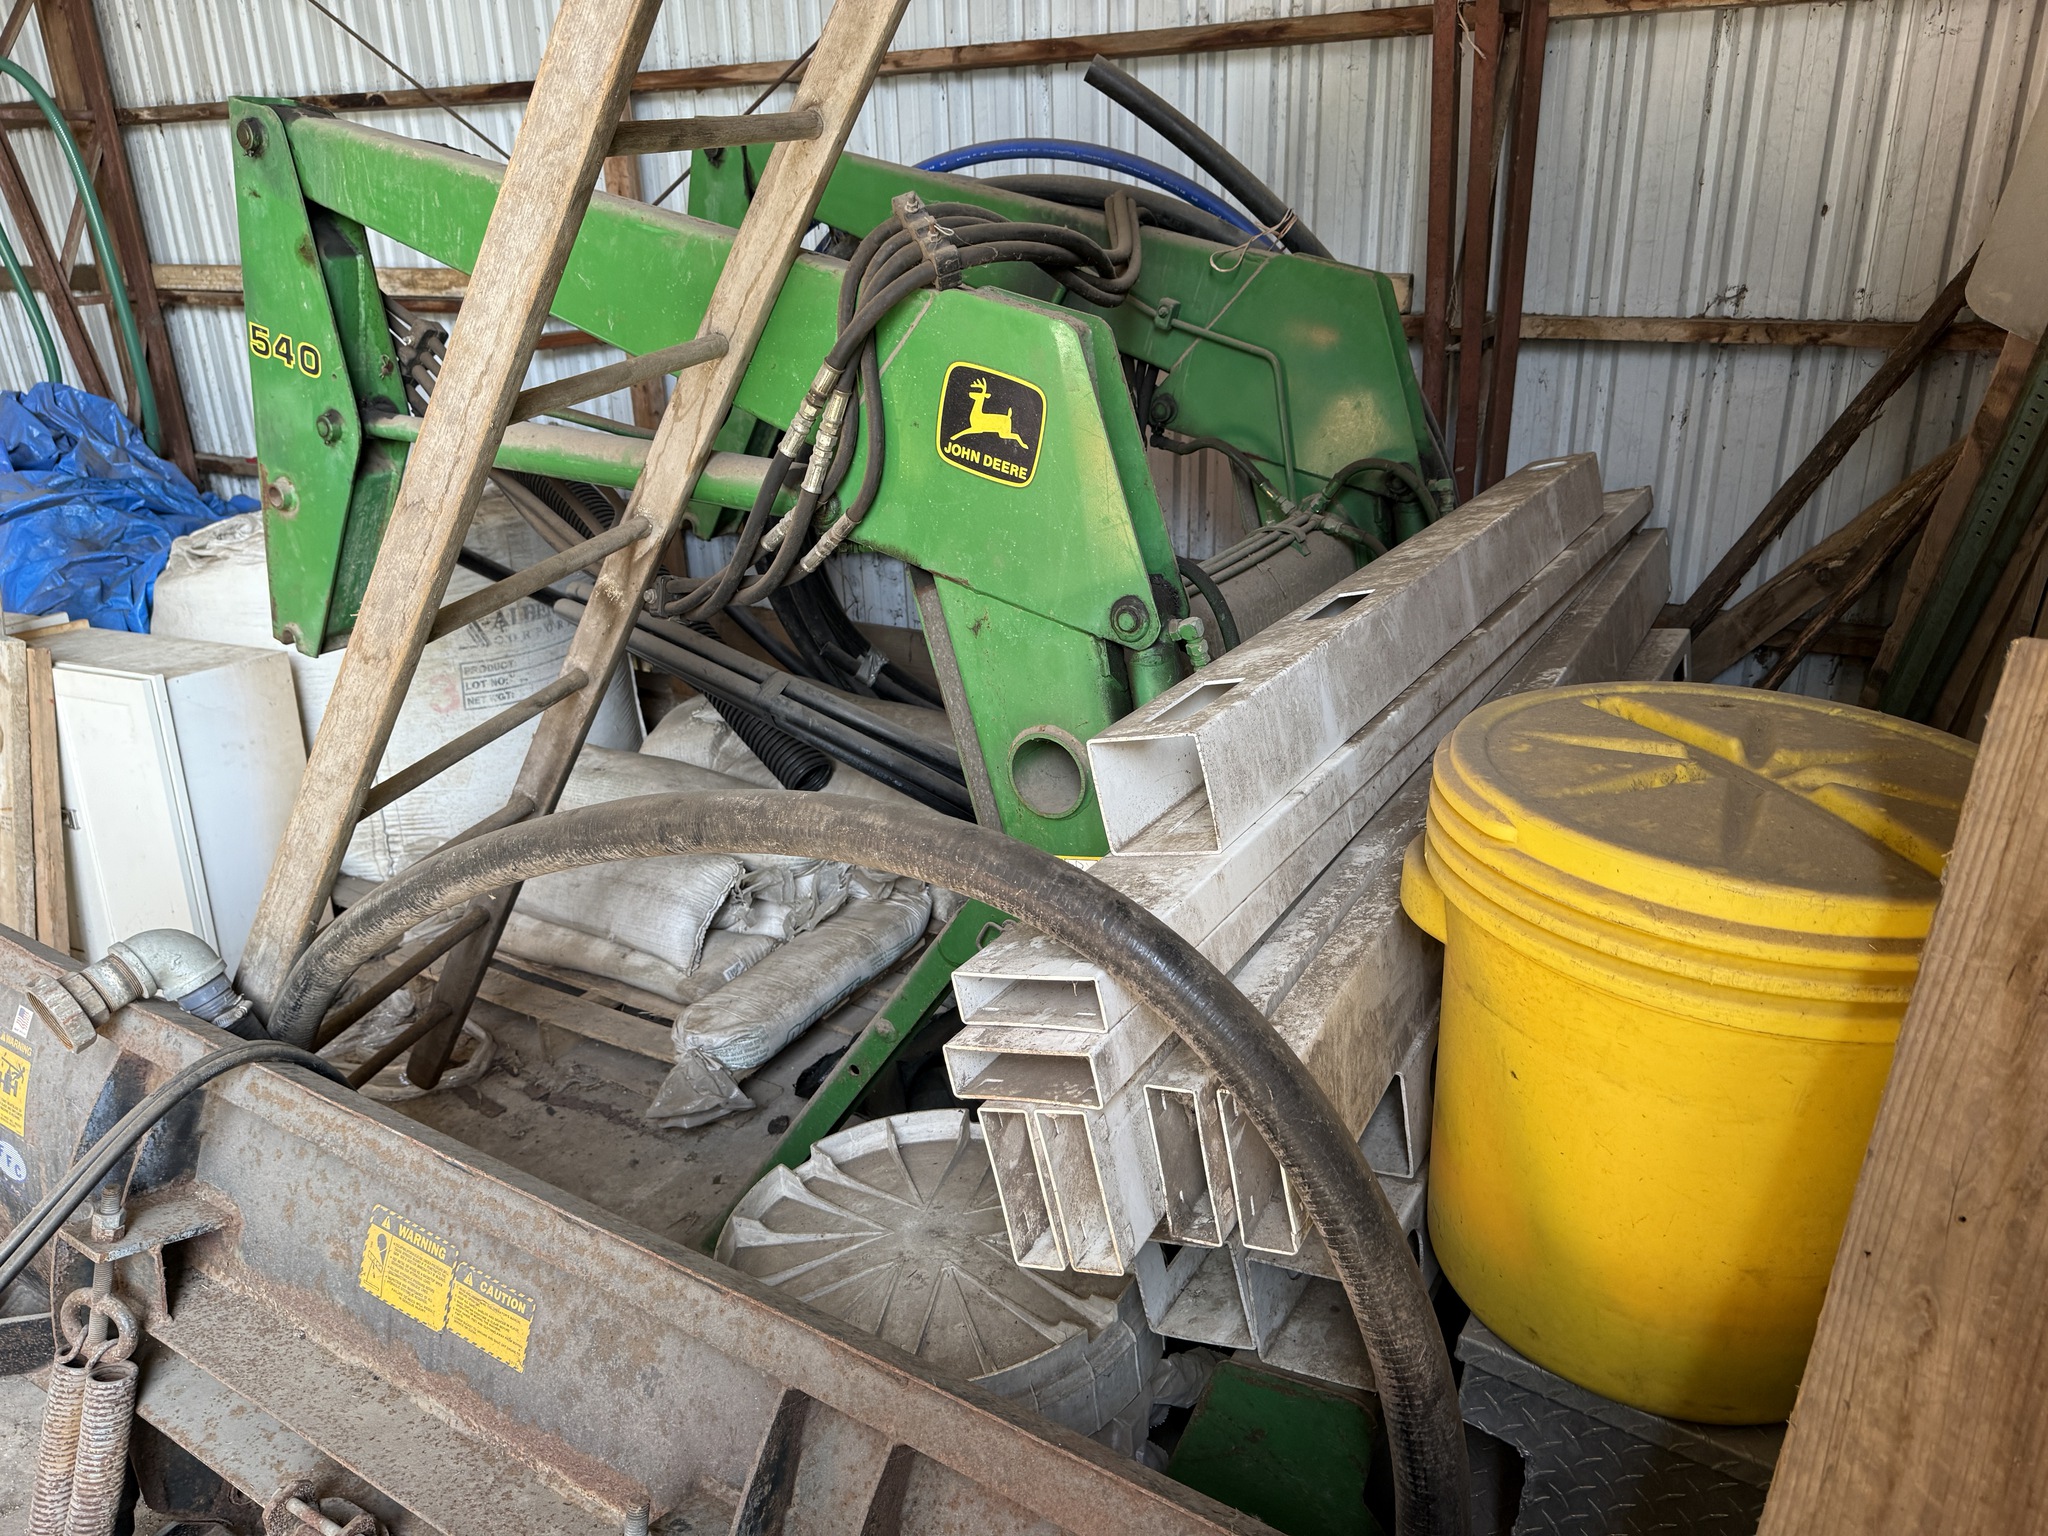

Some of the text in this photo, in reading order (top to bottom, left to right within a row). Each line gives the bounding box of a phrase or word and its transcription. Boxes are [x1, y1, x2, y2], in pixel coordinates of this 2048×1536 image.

[248, 321, 321, 379] 540
[944, 441, 1028, 480] JOHN DEERE
[465, 679, 487, 691] LOT
[490, 676, 509, 688] NO:
[467, 695, 486, 706] NET
[6, 1033, 32, 1057] WARNING
[398, 1223, 447, 1260] WARNING
[480, 1281, 526, 1314] CAUTION
